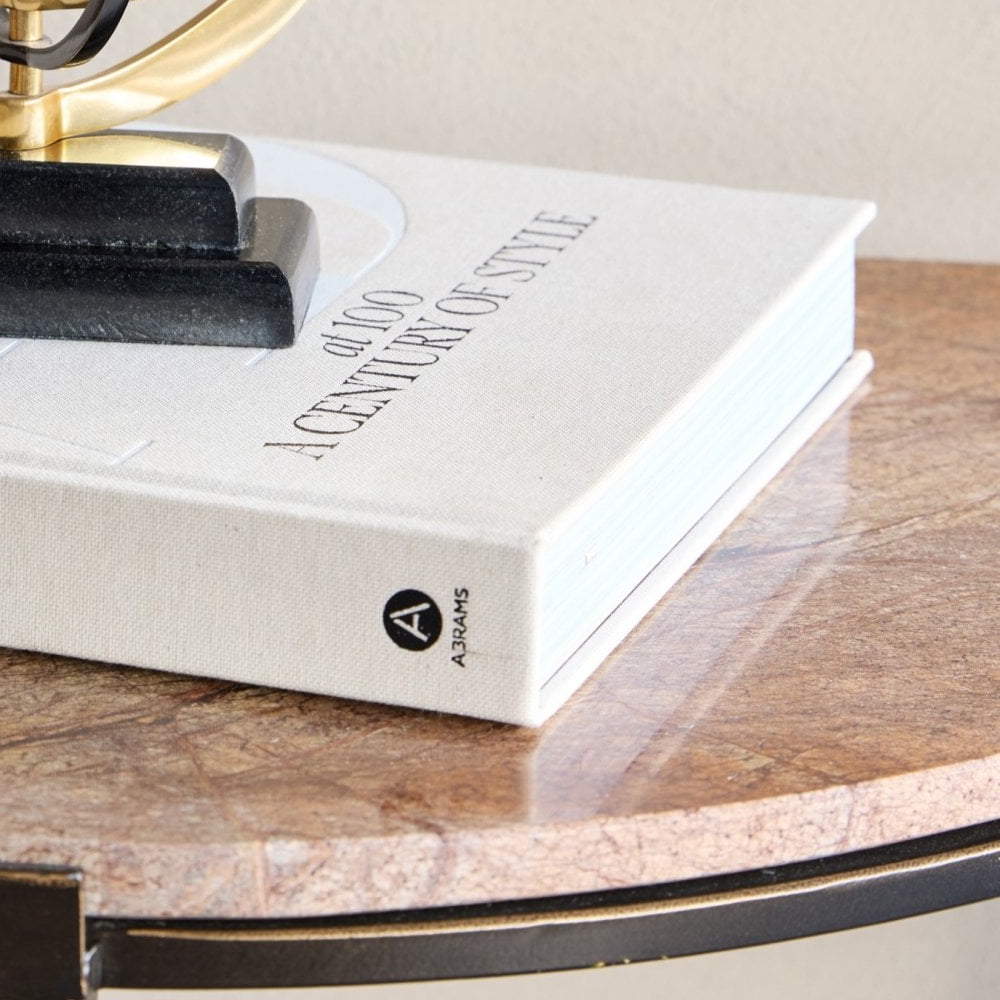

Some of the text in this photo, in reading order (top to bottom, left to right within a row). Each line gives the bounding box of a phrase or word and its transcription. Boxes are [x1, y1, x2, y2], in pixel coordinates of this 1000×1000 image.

[263, 210, 598, 461] A CENTURY OF STYLE
[320, 290, 424, 358] at 100
